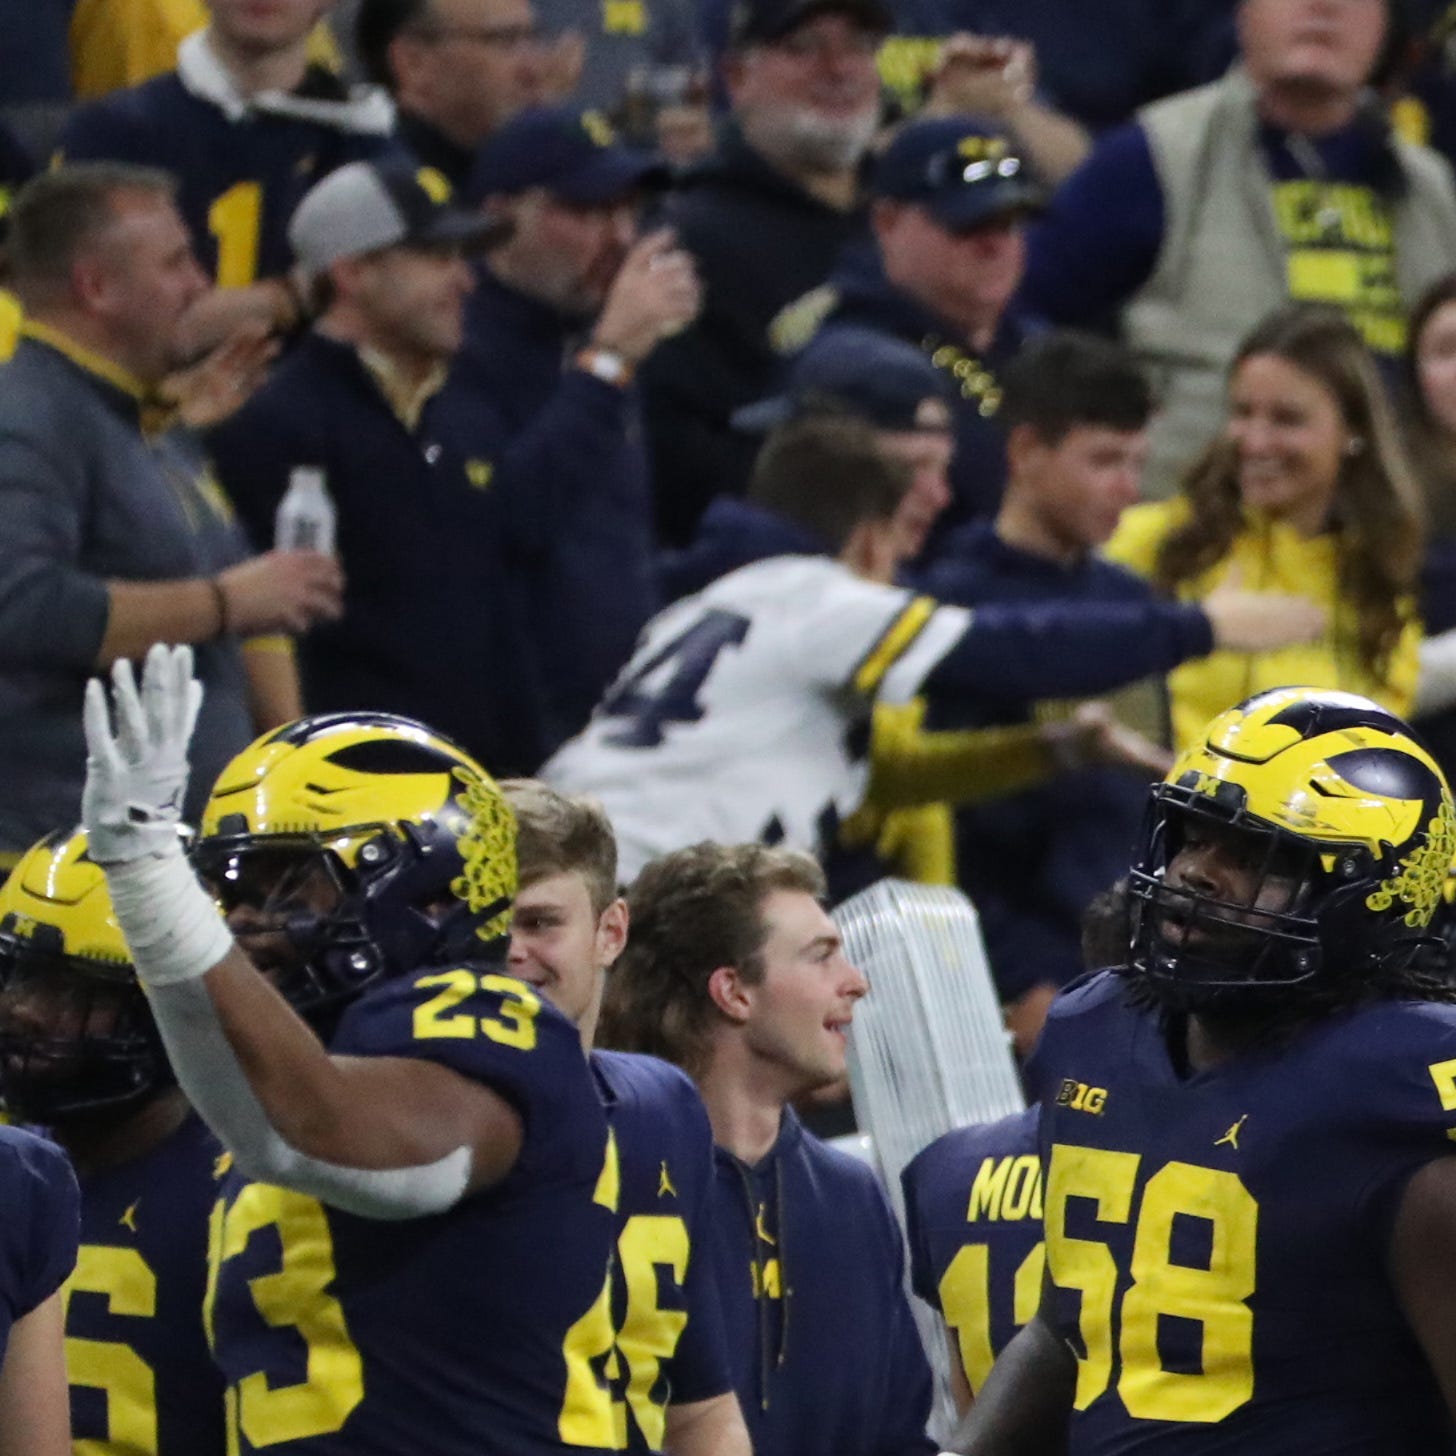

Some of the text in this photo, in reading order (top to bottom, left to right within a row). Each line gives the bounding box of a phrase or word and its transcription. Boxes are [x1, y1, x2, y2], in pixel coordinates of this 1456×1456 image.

[602, 608, 751, 747] 4
[413, 970, 540, 1051] 23
[966, 1155, 1043, 1222] MO
[1045, 1144, 1259, 1423] 58
